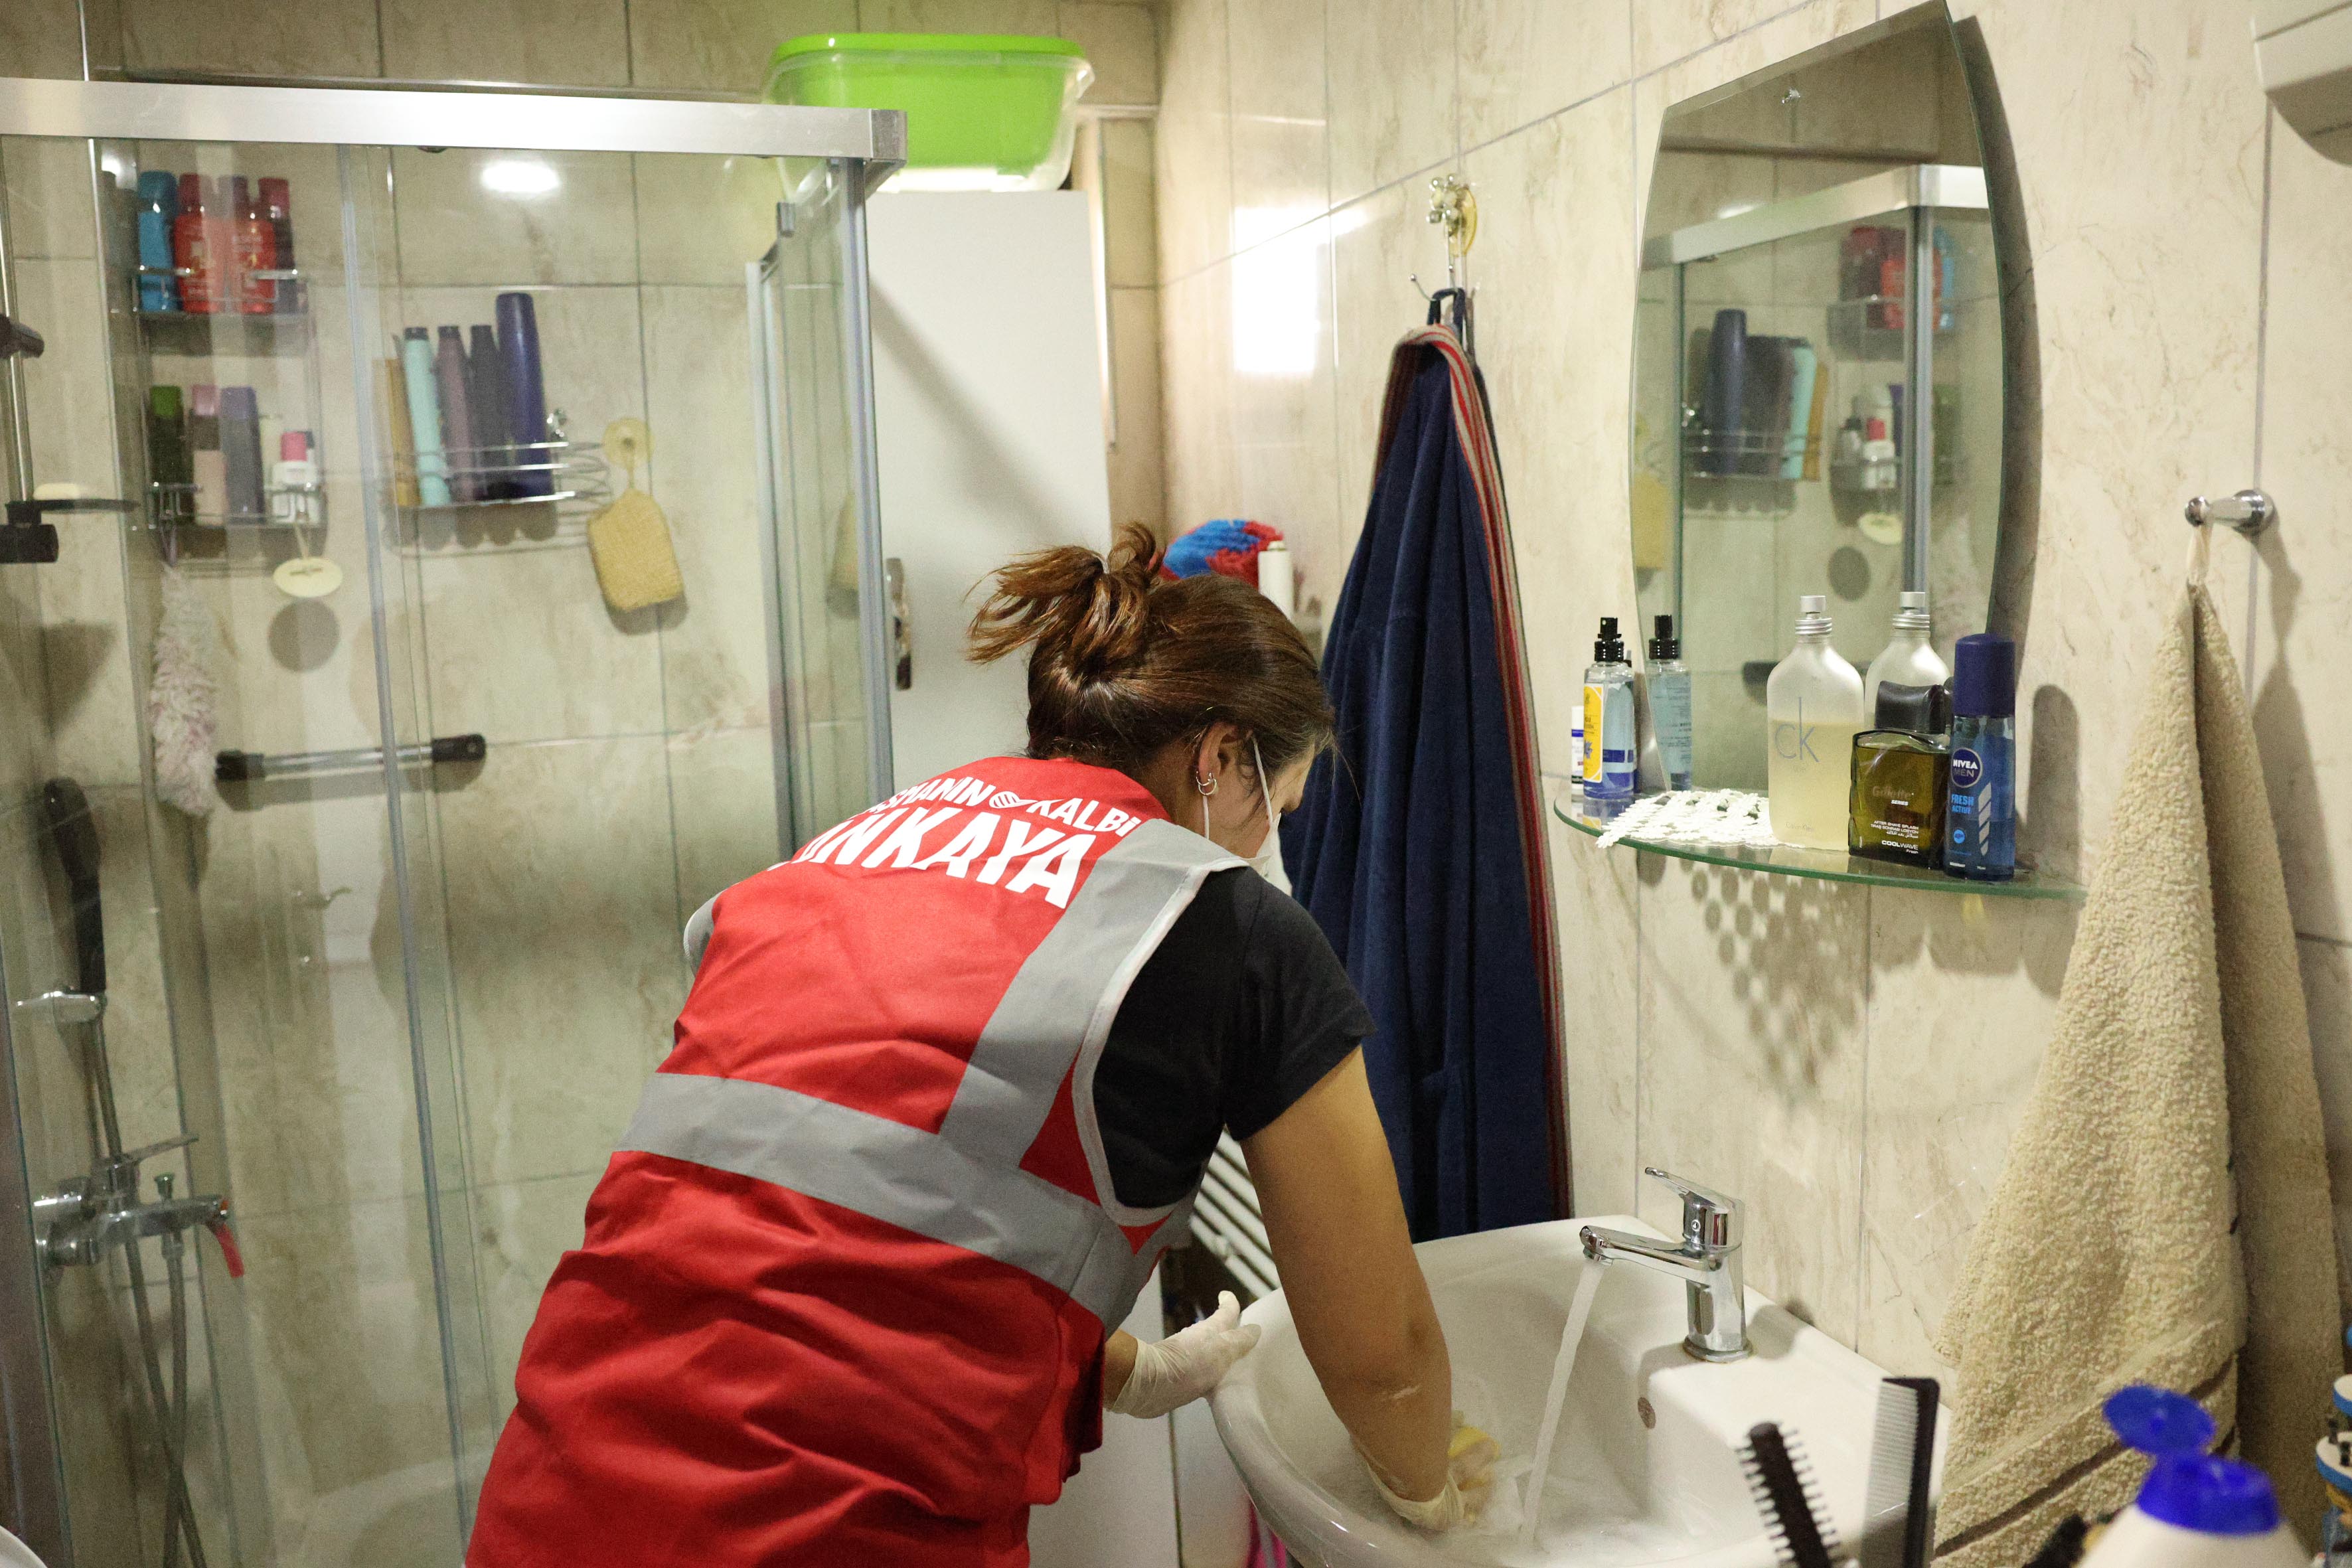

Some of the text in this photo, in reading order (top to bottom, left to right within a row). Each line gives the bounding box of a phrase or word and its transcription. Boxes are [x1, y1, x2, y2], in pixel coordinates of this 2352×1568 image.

[1952, 759, 1978, 769] NIVEA
[1954, 767, 1975, 777] MEN
[1951, 794, 1974, 806] FRESH
[1881, 840, 1919, 850] COOLWAVE
[767, 806, 1097, 909] ANKAYA
